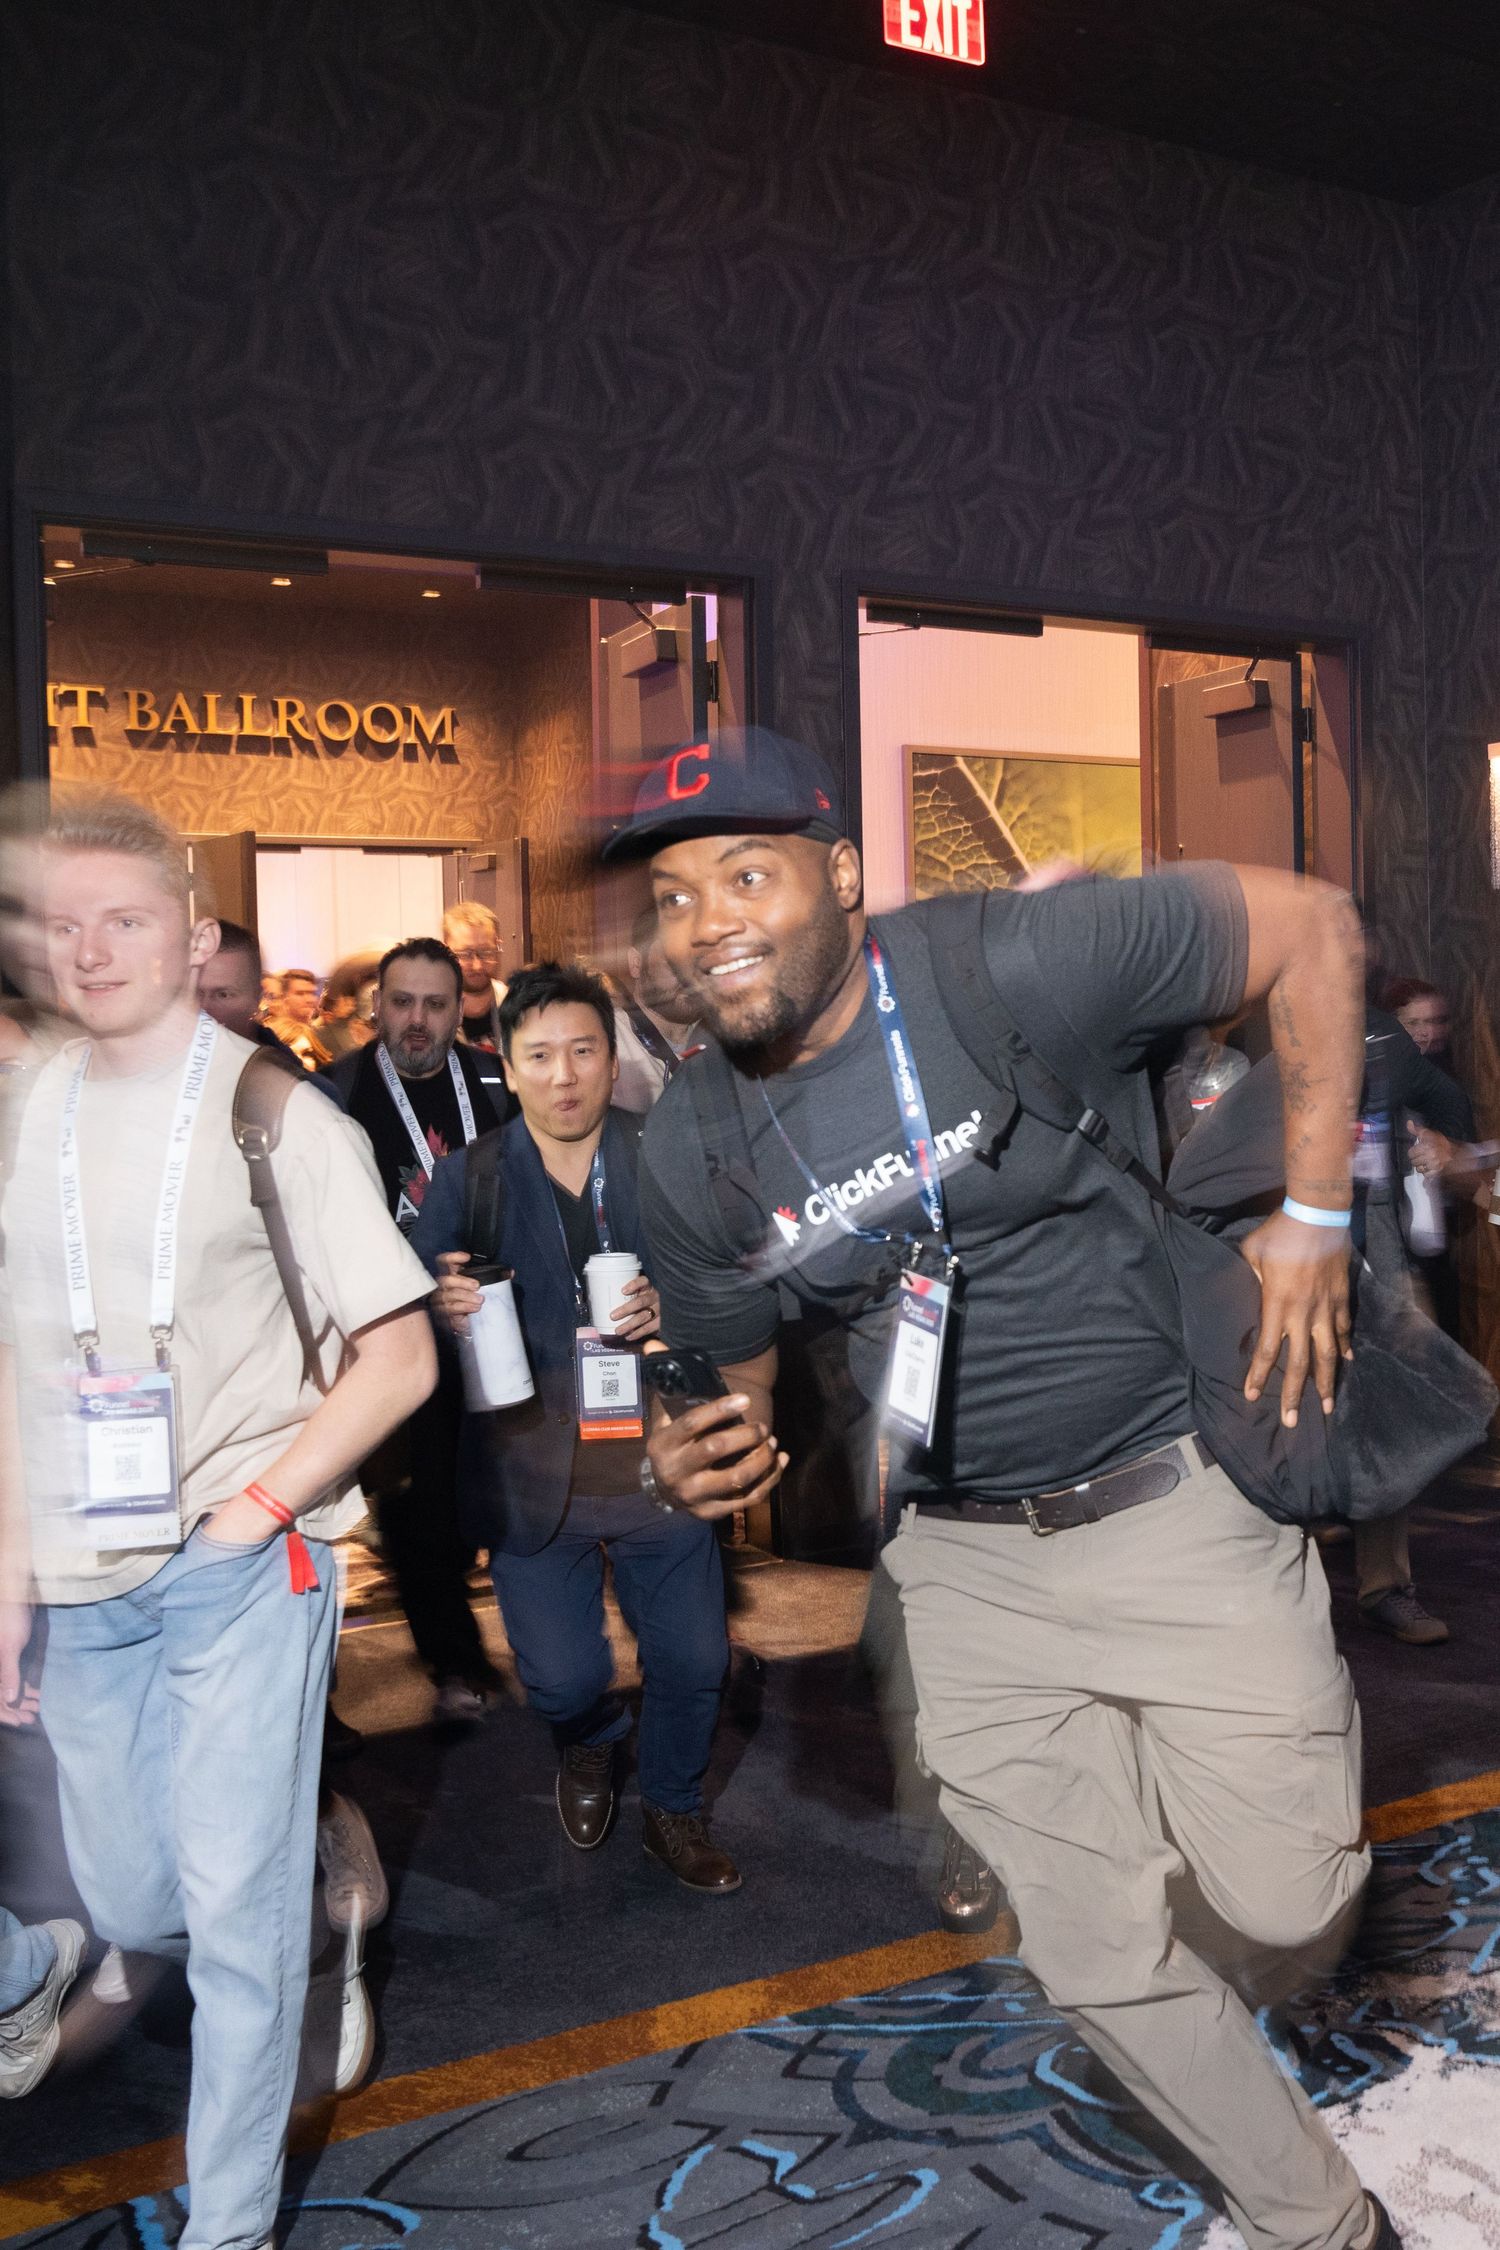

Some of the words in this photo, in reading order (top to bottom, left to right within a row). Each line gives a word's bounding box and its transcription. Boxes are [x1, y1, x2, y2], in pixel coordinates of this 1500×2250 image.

[900, 0, 972, 59] EXIT
[124, 689, 456, 746] BALLROOM
[667, 743, 711, 801] C
[183, 1053, 209, 1100] PRIME
[405, 1113, 424, 1145] MOVER
[63, 1173, 81, 1235] MOVER
[162, 1160, 184, 1223] MOVER
[68, 1239, 87, 1291] PRIME
[158, 1225, 173, 1280] PRIME
[598, 1360, 621, 1368] Steve
[102, 1425, 154, 1437] Christian
